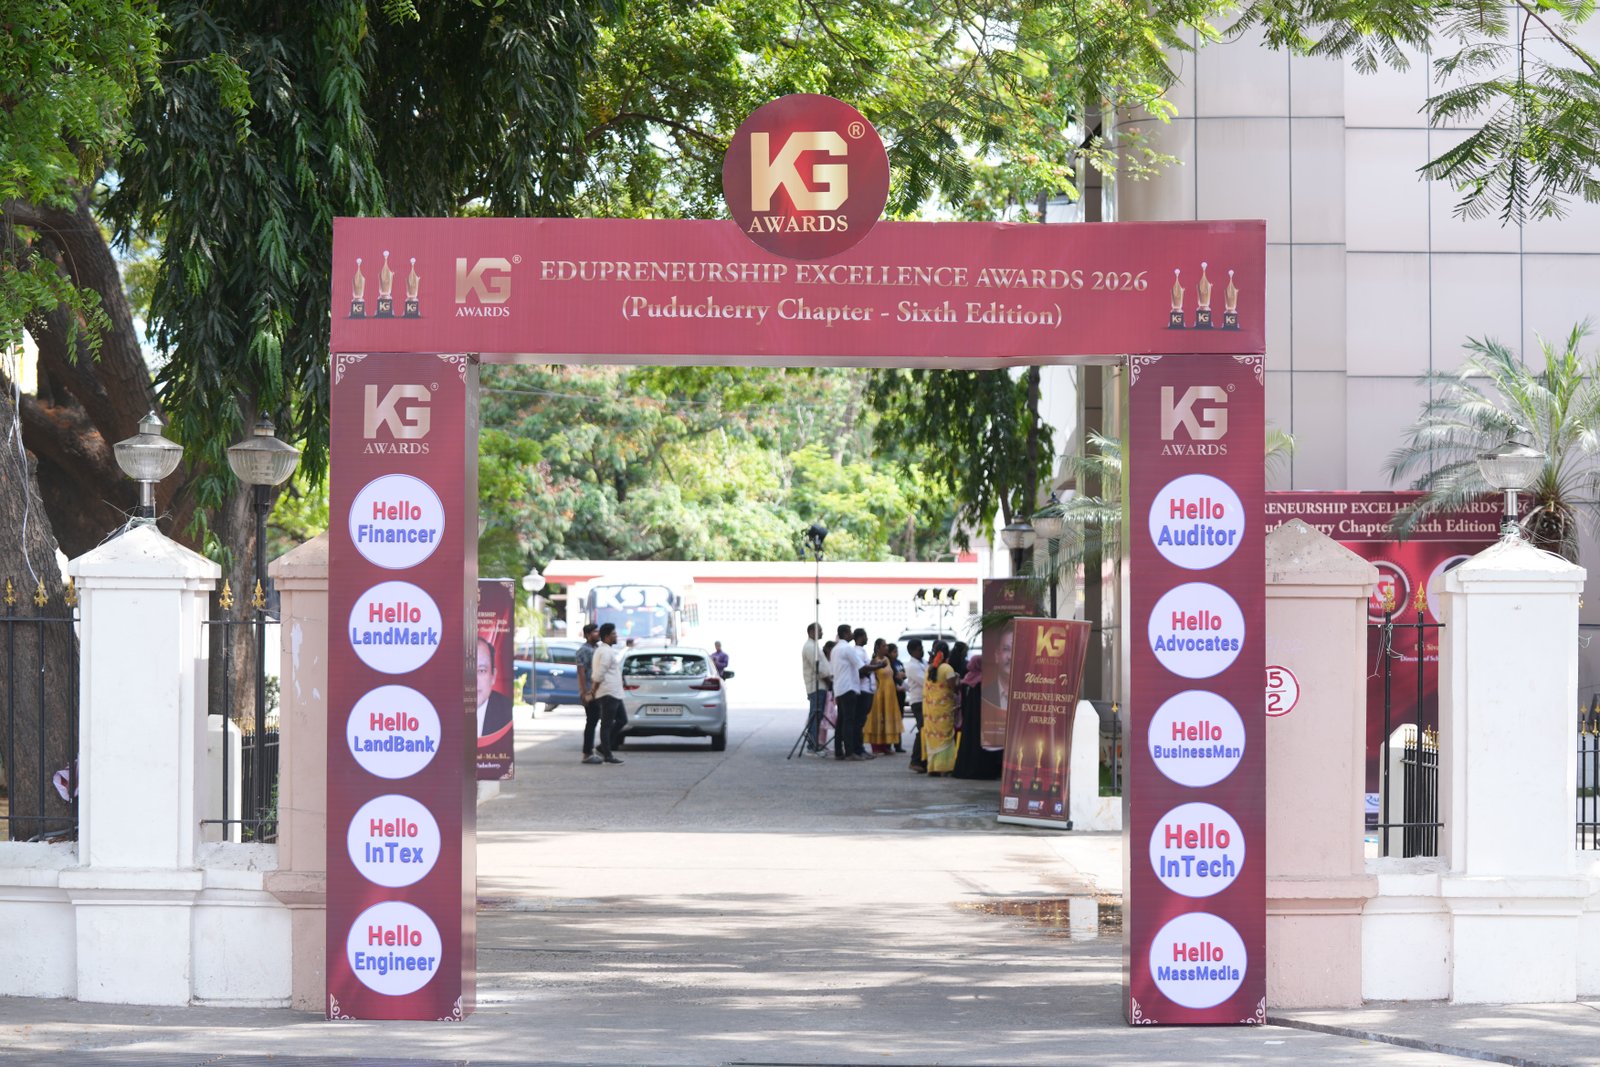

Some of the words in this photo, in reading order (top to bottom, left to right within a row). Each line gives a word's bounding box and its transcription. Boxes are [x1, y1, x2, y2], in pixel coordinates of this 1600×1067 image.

[748, 214, 849, 233] AWARDS
[539, 260, 788, 284] EDUPRENEURSHIP
[795, 264, 969, 288] EXCELLENCE
[975, 267, 1085, 291] AWARDS
[1091, 270, 1149, 292] 2026
[455, 306, 511, 317] AWARDS
[621, 295, 771, 326] (Puducherry
[777, 297, 874, 327] Chapter
[896, 300, 959, 323] Sixth
[964, 302, 1063, 329] Edition)
[363, 442, 431, 455] AWARDS
[1161, 443, 1228, 456] AWARDS
[372, 501, 422, 521] Hello
[1169, 498, 1225, 520] Hello
[357, 523, 437, 543] Financer
[1157, 524, 1237, 546] Auditor
[1338, 519, 1394, 537] Chapter
[1446, 519, 1496, 533] Edition
[369, 602, 421, 623] Hello
[1171, 610, 1222, 631] Hello
[352, 627, 438, 646] LandMark
[1154, 634, 1240, 652] Advocates
[1024, 672, 1057, 684] Welcome
[1268, 693, 1283, 712] 2
[370, 712, 419, 731] Hello
[1172, 720, 1223, 741] Hello
[354, 735, 435, 754] LandBank
[1153, 745, 1241, 759] BusinessMan
[370, 818, 418, 838] Hello
[1165, 823, 1231, 849] Hello
[365, 842, 424, 864] InTex
[1160, 854, 1236, 878] InTech
[368, 924, 422, 947] Hello
[1173, 942, 1225, 963] Hello
[354, 951, 435, 976] Engineer
[1157, 965, 1240, 981] MassMedia
